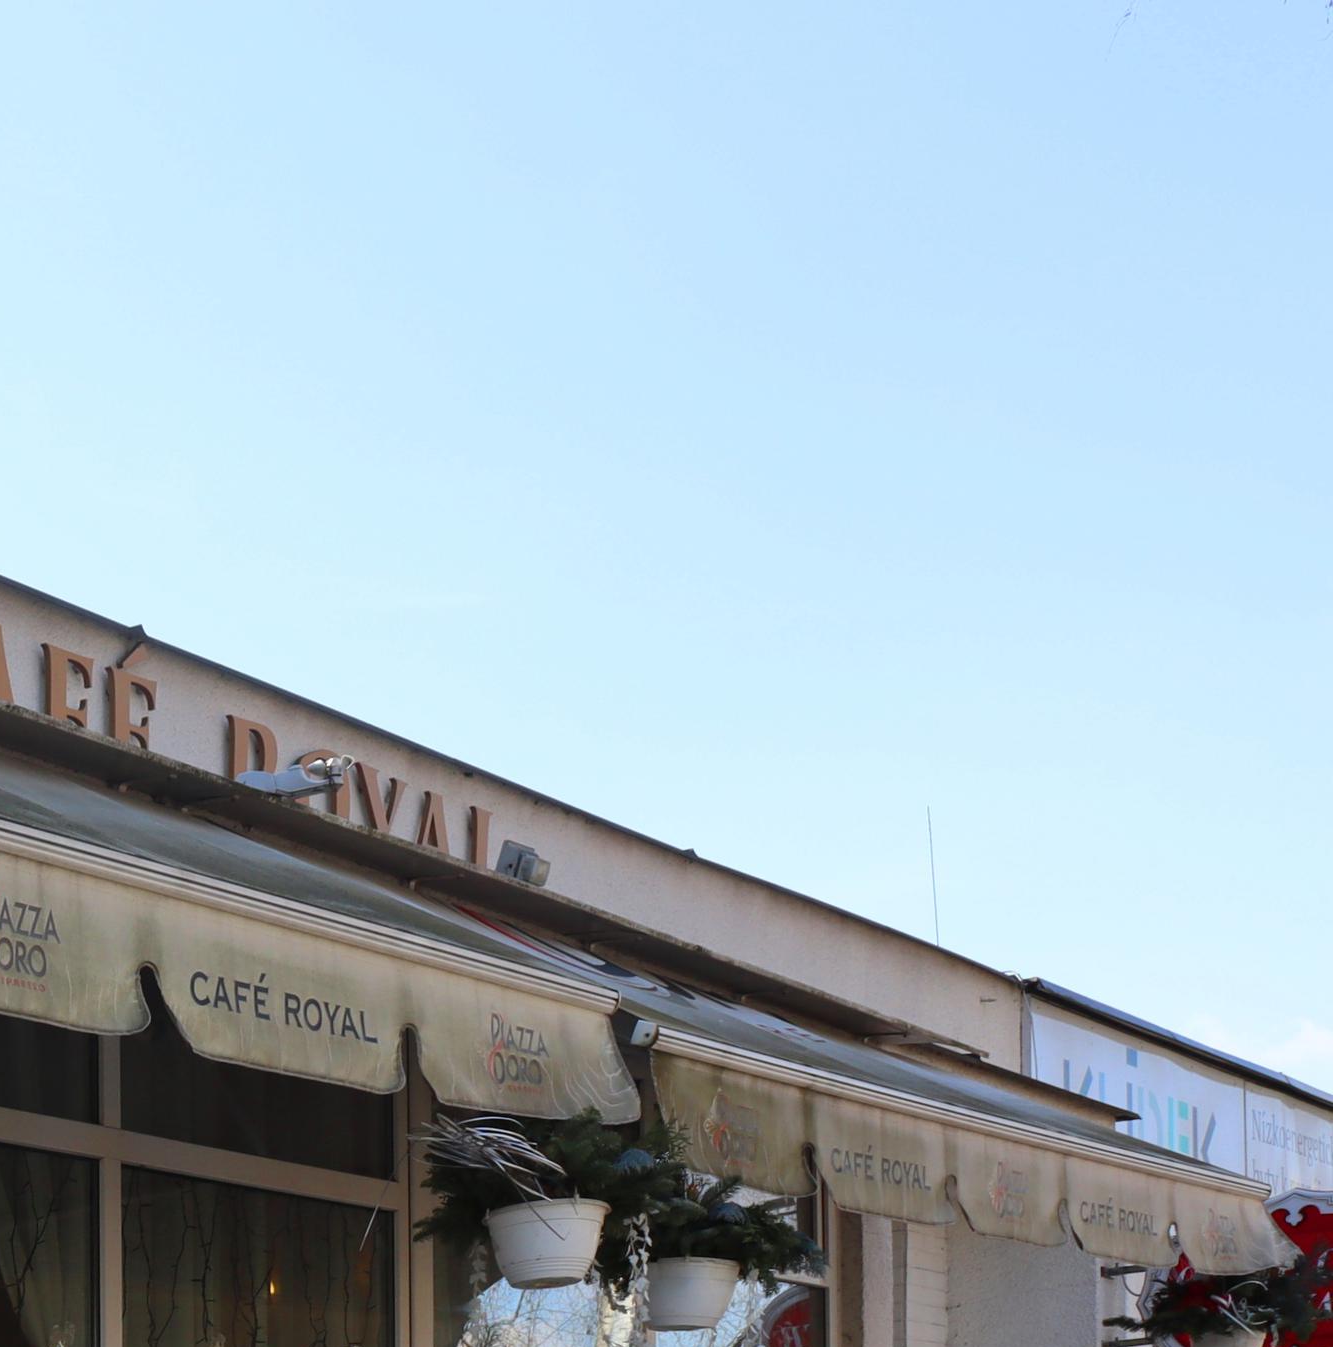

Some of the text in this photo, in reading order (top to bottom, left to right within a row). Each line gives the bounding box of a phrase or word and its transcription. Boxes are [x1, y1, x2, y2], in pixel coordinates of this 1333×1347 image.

[189, 971, 379, 1044] CAFÉ ROYAL
[830, 1145, 933, 1192] CAFÉ ROYAL
[1079, 1197, 1158, 1237] CAFÉ ROYAL
